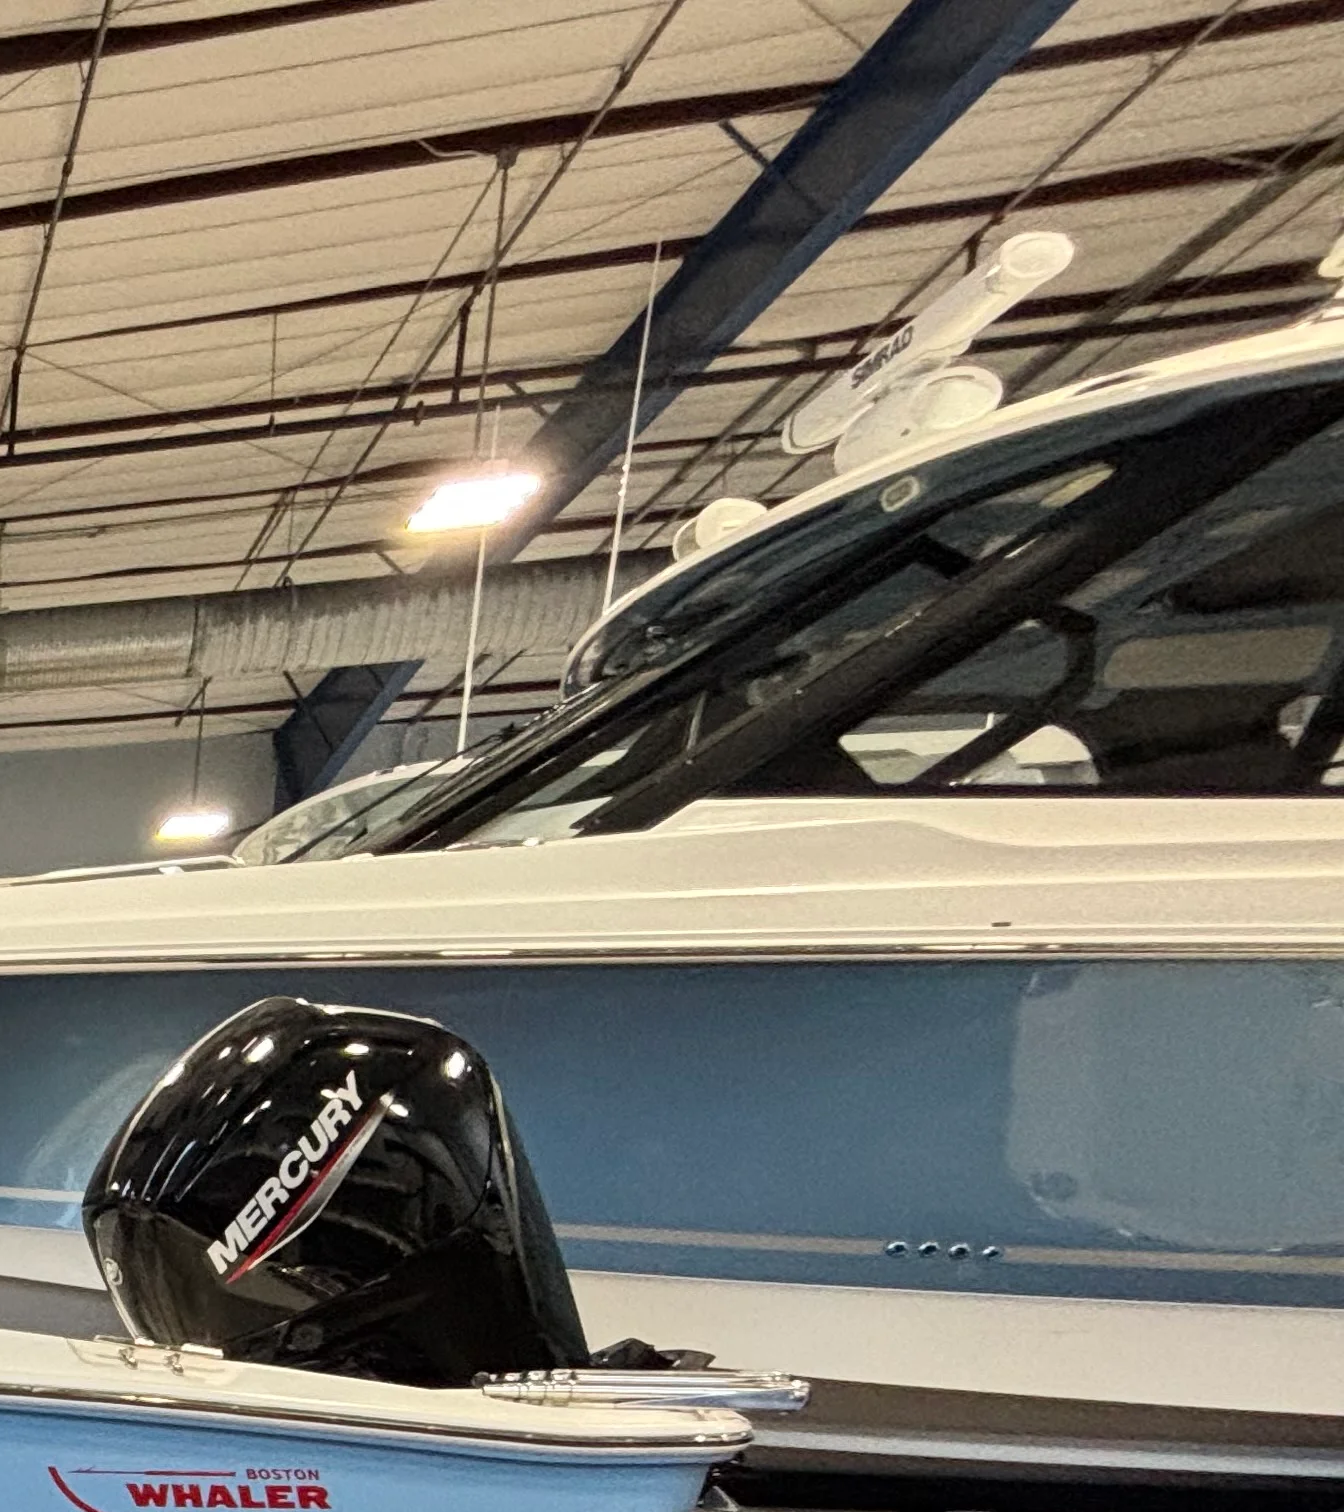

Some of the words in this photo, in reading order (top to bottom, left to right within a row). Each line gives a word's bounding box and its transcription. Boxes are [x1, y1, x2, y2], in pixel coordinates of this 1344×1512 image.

[207, 1069, 363, 1275] MERCURY
[246, 1468, 320, 1481] BOSTON
[125, 1483, 332, 1509] WHALER
